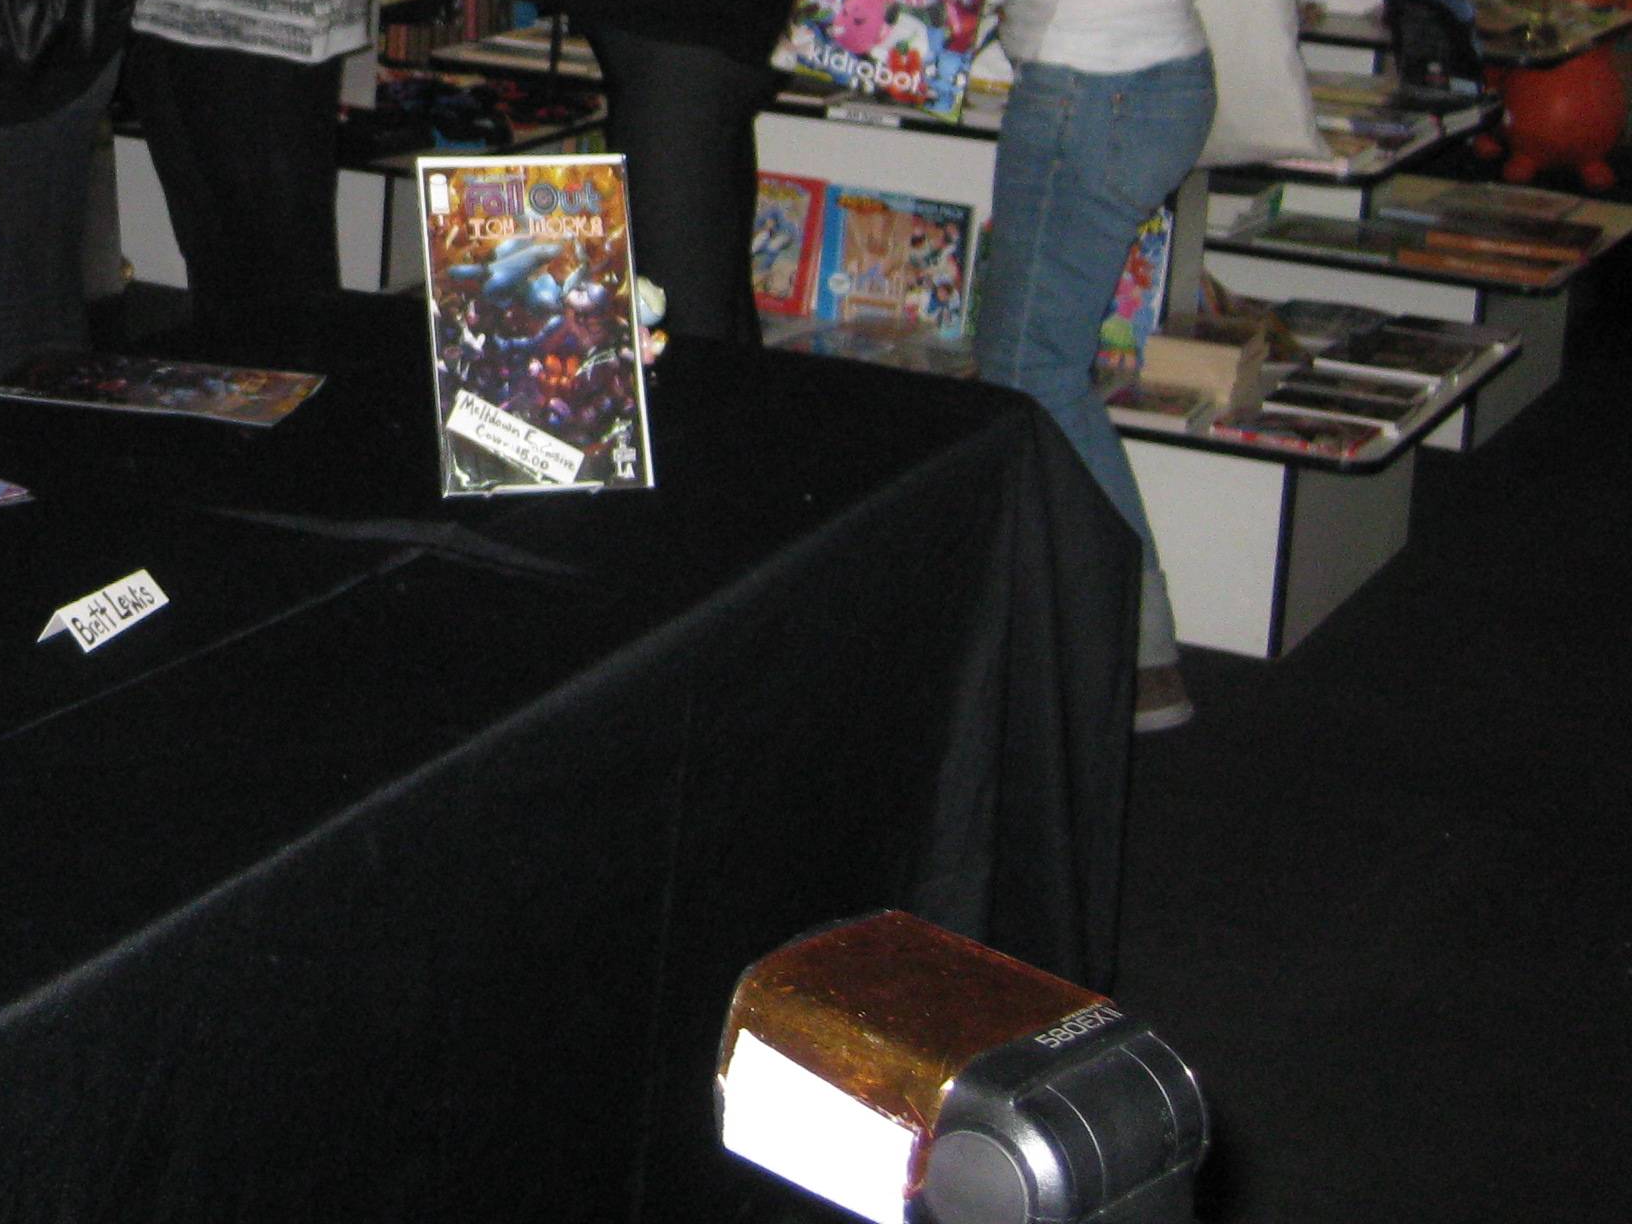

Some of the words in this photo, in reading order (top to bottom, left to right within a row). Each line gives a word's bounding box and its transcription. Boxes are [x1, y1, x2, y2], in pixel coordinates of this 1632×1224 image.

[806, 41, 922, 94] kidrobot
[528, 180, 603, 216] Out
[460, 394, 520, 438] Meltdown
[71, 598, 118, 645] Brett
[102, 585, 156, 620] Lewis
